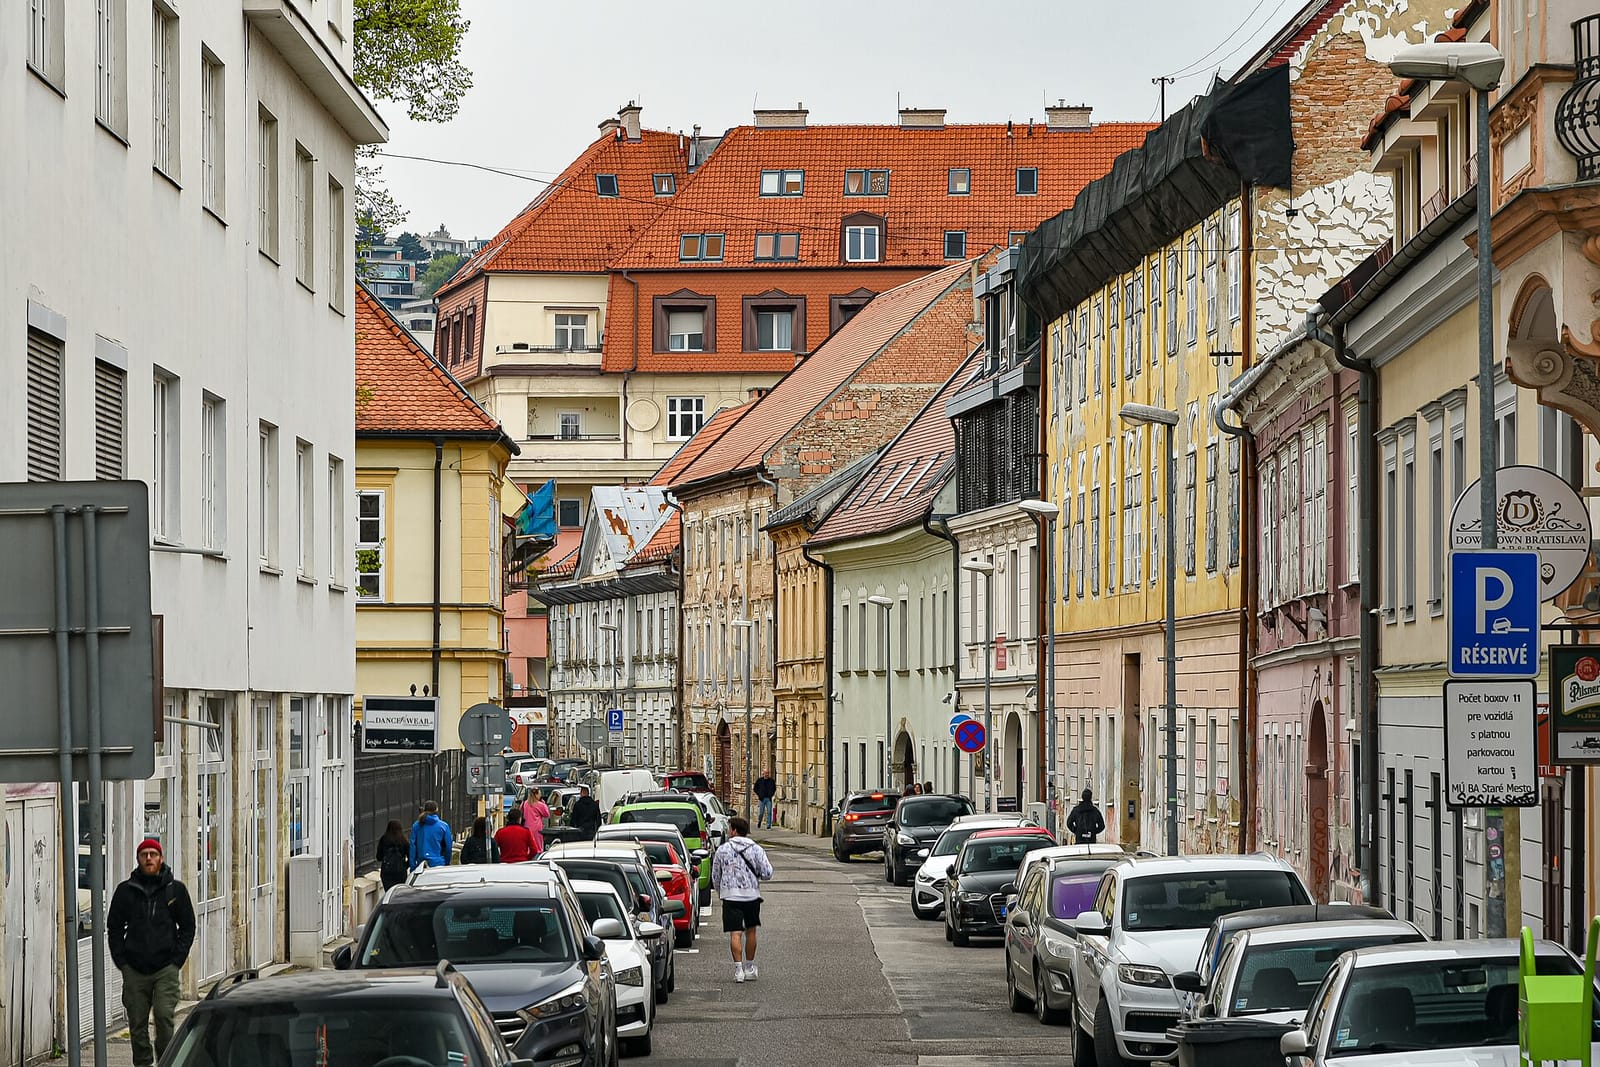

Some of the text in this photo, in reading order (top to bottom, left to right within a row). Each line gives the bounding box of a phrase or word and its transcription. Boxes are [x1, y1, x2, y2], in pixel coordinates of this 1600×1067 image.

[1456, 535, 1586, 545] DOWOWN BRATISLAVA
[1475, 567, 1514, 634] P
[1461, 642, 1528, 665] RÉSERVÉ
[1458, 693, 1521, 703] Počet boxov 11
[1569, 681, 1600, 703] Pilsner
[1467, 710, 1513, 723] pre vozidlá
[1470, 730, 1511, 741] s platnou
[1467, 747, 1515, 759] parkovacou
[1477, 765, 1505, 775] kartou
[1451, 781, 1532, 793] MÚ BA Staré Mesto
